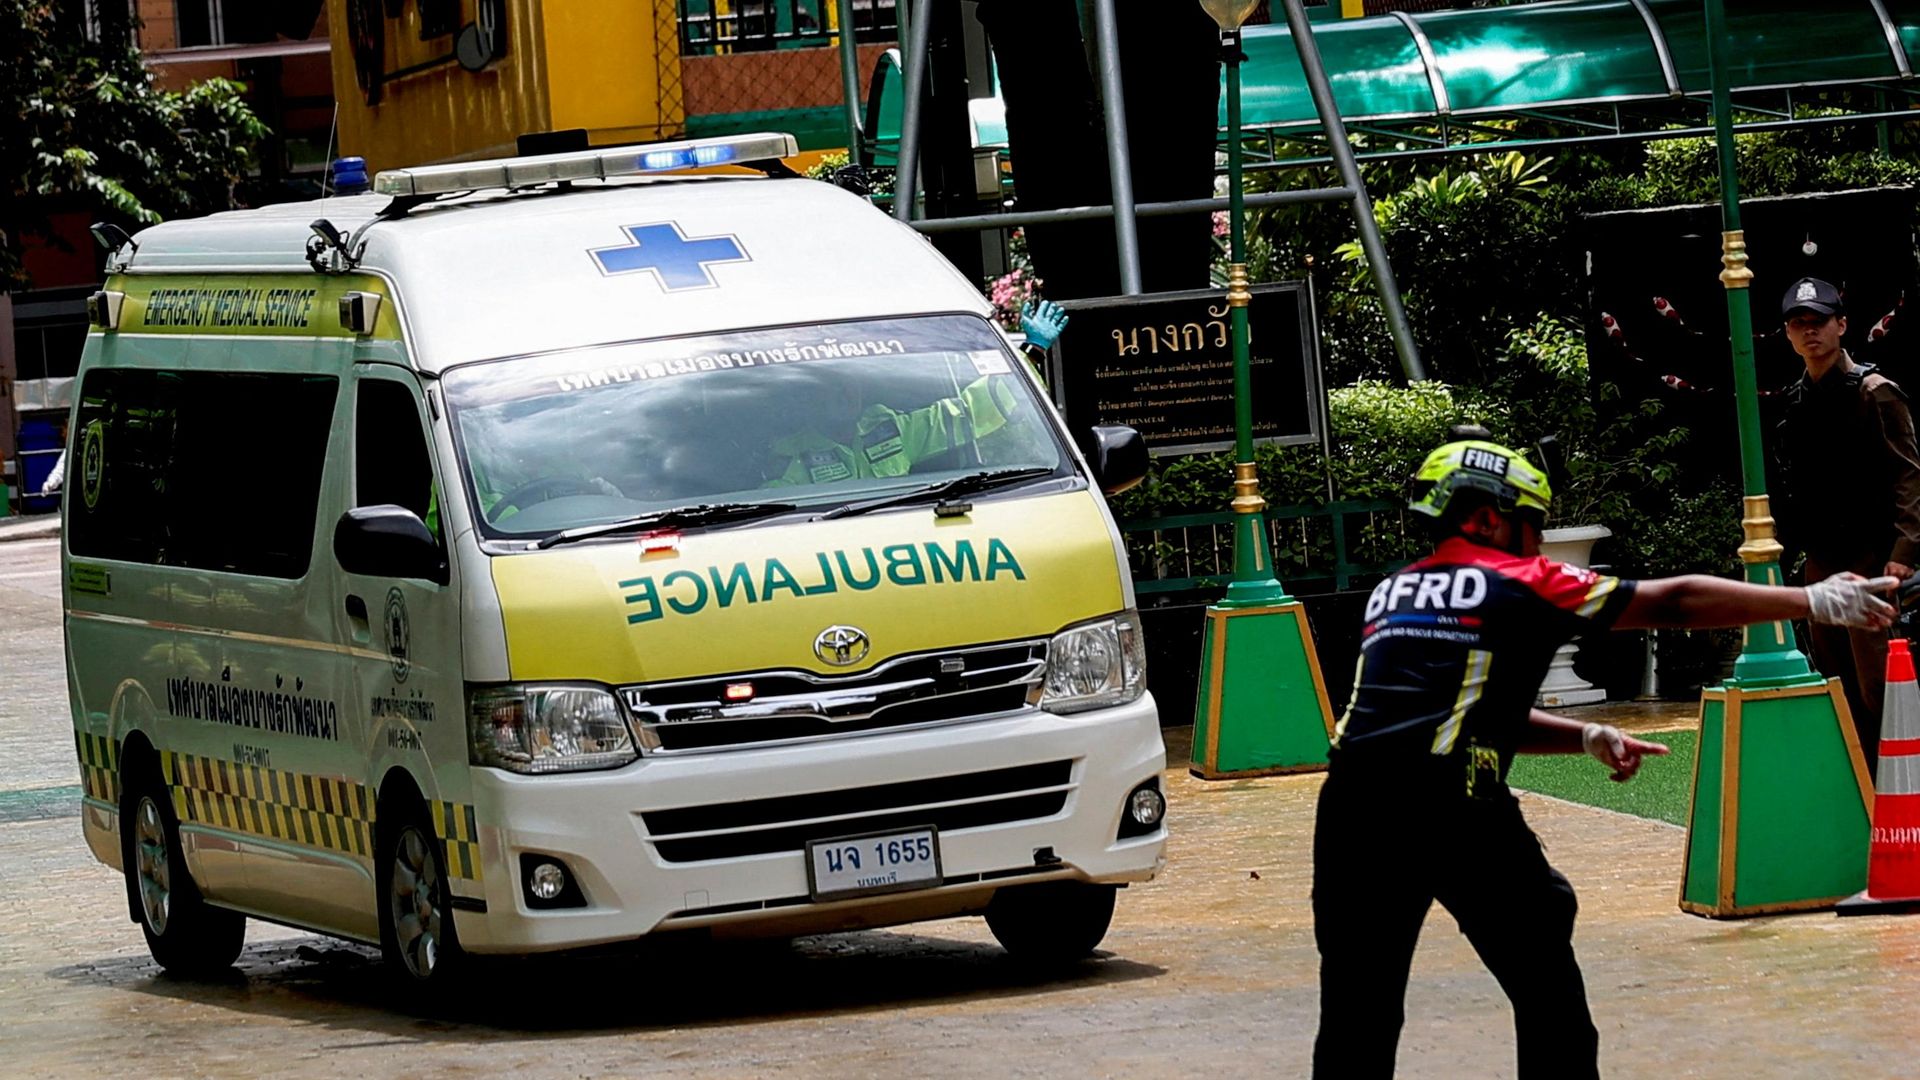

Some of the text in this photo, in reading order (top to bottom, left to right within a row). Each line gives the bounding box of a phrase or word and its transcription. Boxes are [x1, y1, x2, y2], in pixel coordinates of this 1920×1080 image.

[144, 289, 316, 327] EMERGENCY MEDICAL SERVICE
[1111, 303, 1253, 357] นางกวั
[558, 338, 906, 392] เทศบาลเมองบางรักพัฒนา
[1464, 449, 1507, 473] FIRE
[1364, 567, 1488, 622] BFRD
[825, 836, 931, 873] นจ 1655
[857, 870, 897, 887] นนทบรี
